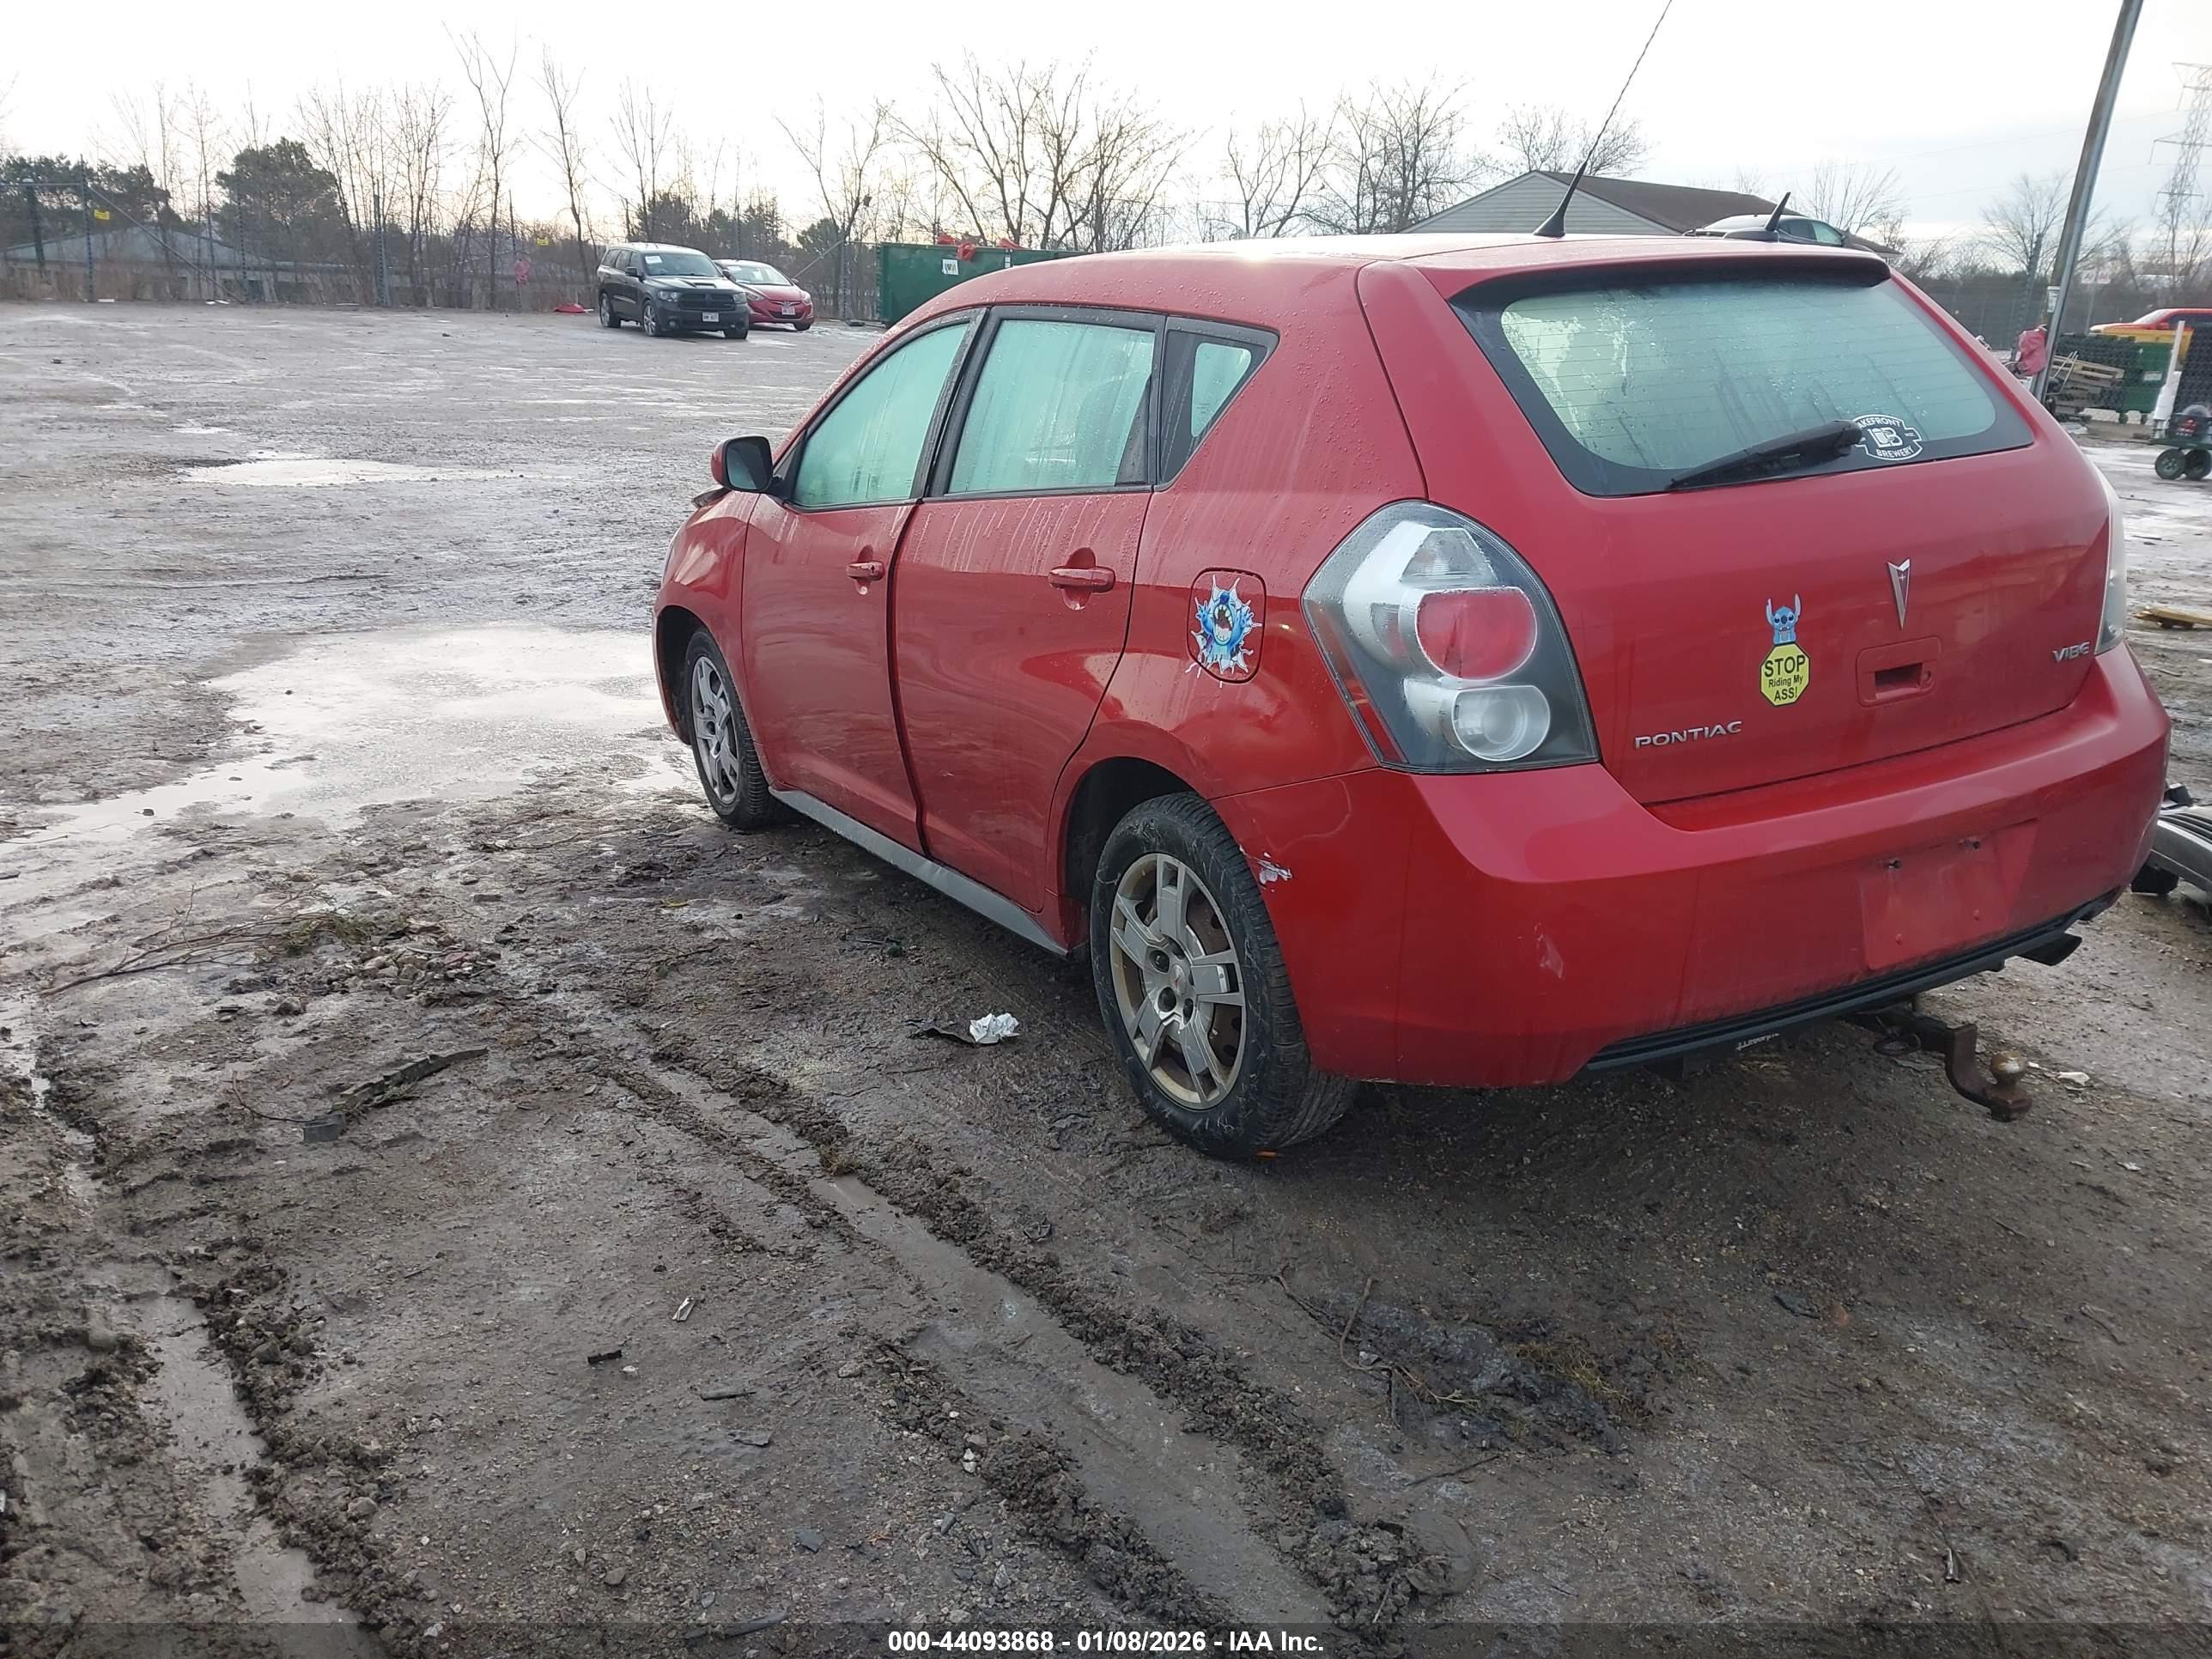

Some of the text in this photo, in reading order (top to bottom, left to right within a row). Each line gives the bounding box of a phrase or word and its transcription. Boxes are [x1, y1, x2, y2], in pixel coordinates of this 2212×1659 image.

[1856, 416, 1902, 428] AKEFRONT
[1875, 445, 1915, 458] BREWERY
[2052, 641, 2090, 663] VIBE
[1765, 654, 1806, 678] STOP
[1768, 674, 1803, 688] Riding My
[1774, 686, 1798, 702] ASS!
[1634, 720, 1742, 750] PONTIAC
